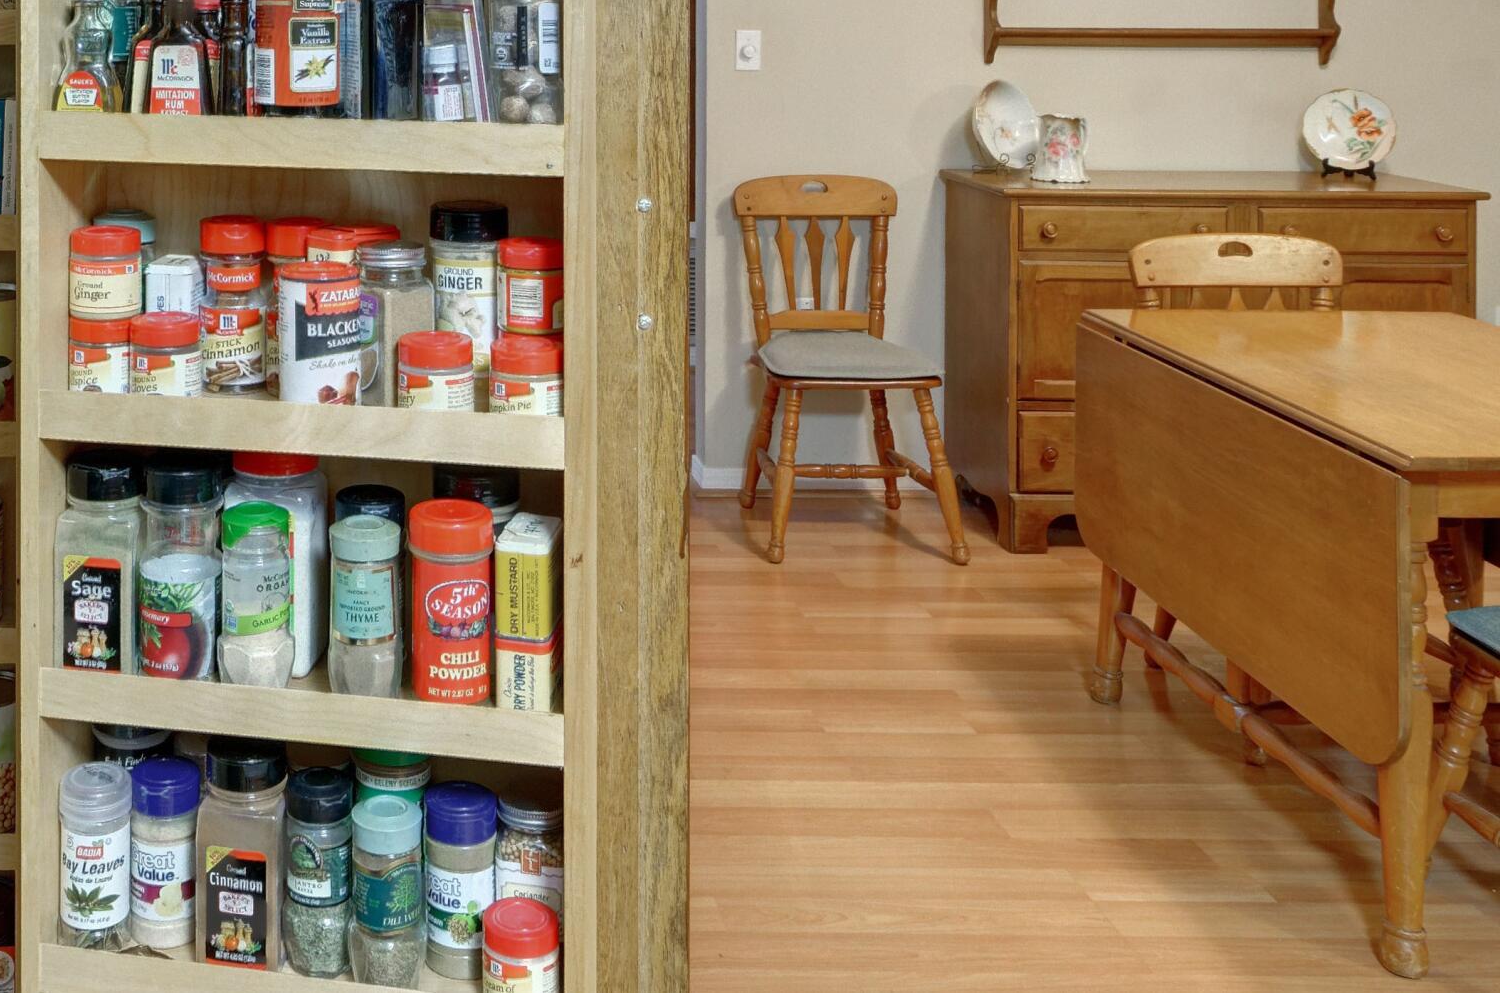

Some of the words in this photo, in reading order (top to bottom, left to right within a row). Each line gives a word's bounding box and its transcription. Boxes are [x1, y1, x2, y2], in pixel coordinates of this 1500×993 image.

[301, 28, 330, 37] Vanilla
[156, 90, 195, 100] IMITATION
[165, 100, 185, 109] RUM
[443, 267, 474, 276] GROUND
[437, 275, 483, 291] GINGER
[73, 288, 112, 302] Ginger
[215, 338, 242, 349] STICK
[71, 580, 112, 597] Sage
[509, 557, 519, 612] MUSTARD
[451, 583, 478, 601] 5th
[431, 593, 488, 619] SEASON
[251, 615, 279, 628] GARLIC
[345, 612, 380, 623] THYME
[510, 614, 519, 634] DRY
[441, 650, 480, 665] CHILI
[429, 663, 487, 680] POWDER
[514, 654, 525, 691] POWDER
[77, 848, 101, 856] BADIA
[82, 855, 125, 875] Leaves
[138, 868, 175, 881] Value
[209, 871, 263, 893] Cinnamon
[514, 889, 550, 902] Coriander
